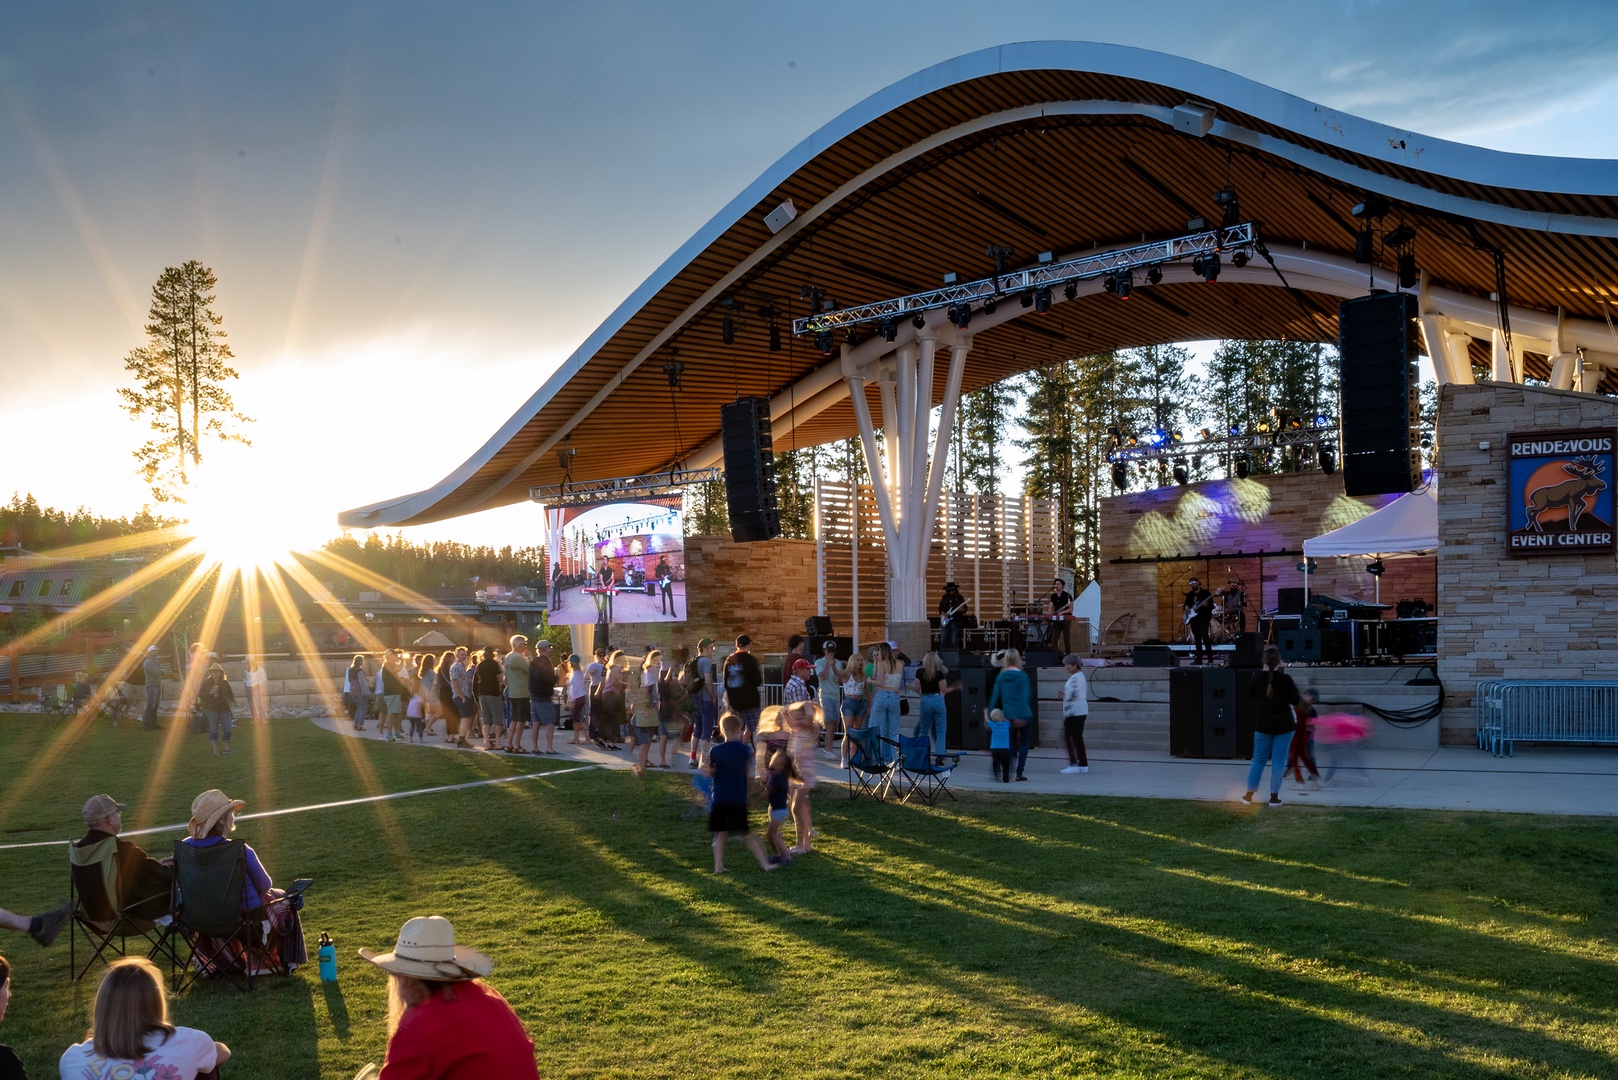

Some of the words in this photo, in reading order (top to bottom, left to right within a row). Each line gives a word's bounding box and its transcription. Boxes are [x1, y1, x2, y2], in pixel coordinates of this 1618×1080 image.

[1511, 437, 1612, 456] RENDEZVOUS
[1511, 534, 1556, 547] EVENT
[1558, 532, 1611, 546] CENTER
